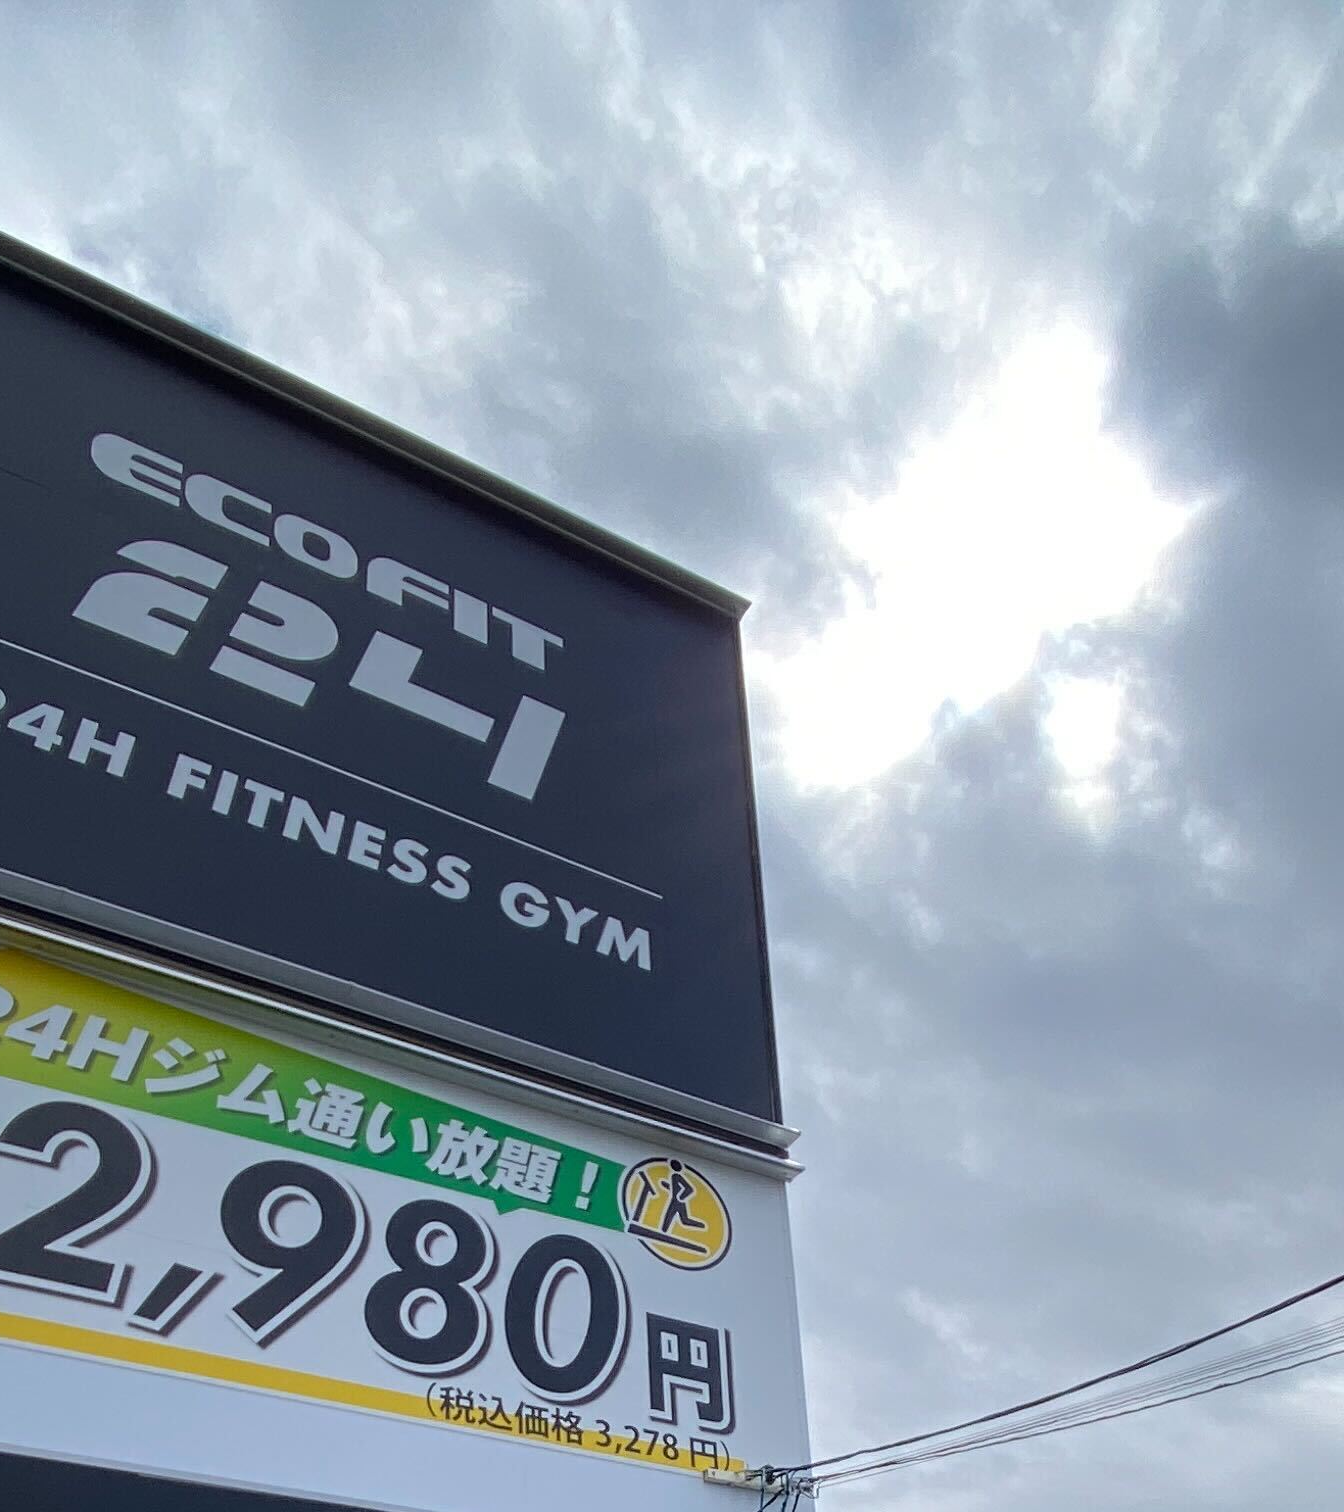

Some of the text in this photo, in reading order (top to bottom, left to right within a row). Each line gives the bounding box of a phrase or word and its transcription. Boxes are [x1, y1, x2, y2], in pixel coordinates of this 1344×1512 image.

[72, 538, 566, 801] 24
[90, 431, 564, 672] ECOFIT
[165, 753, 471, 903] FITNESS
[499, 878, 653, 971] GYM
